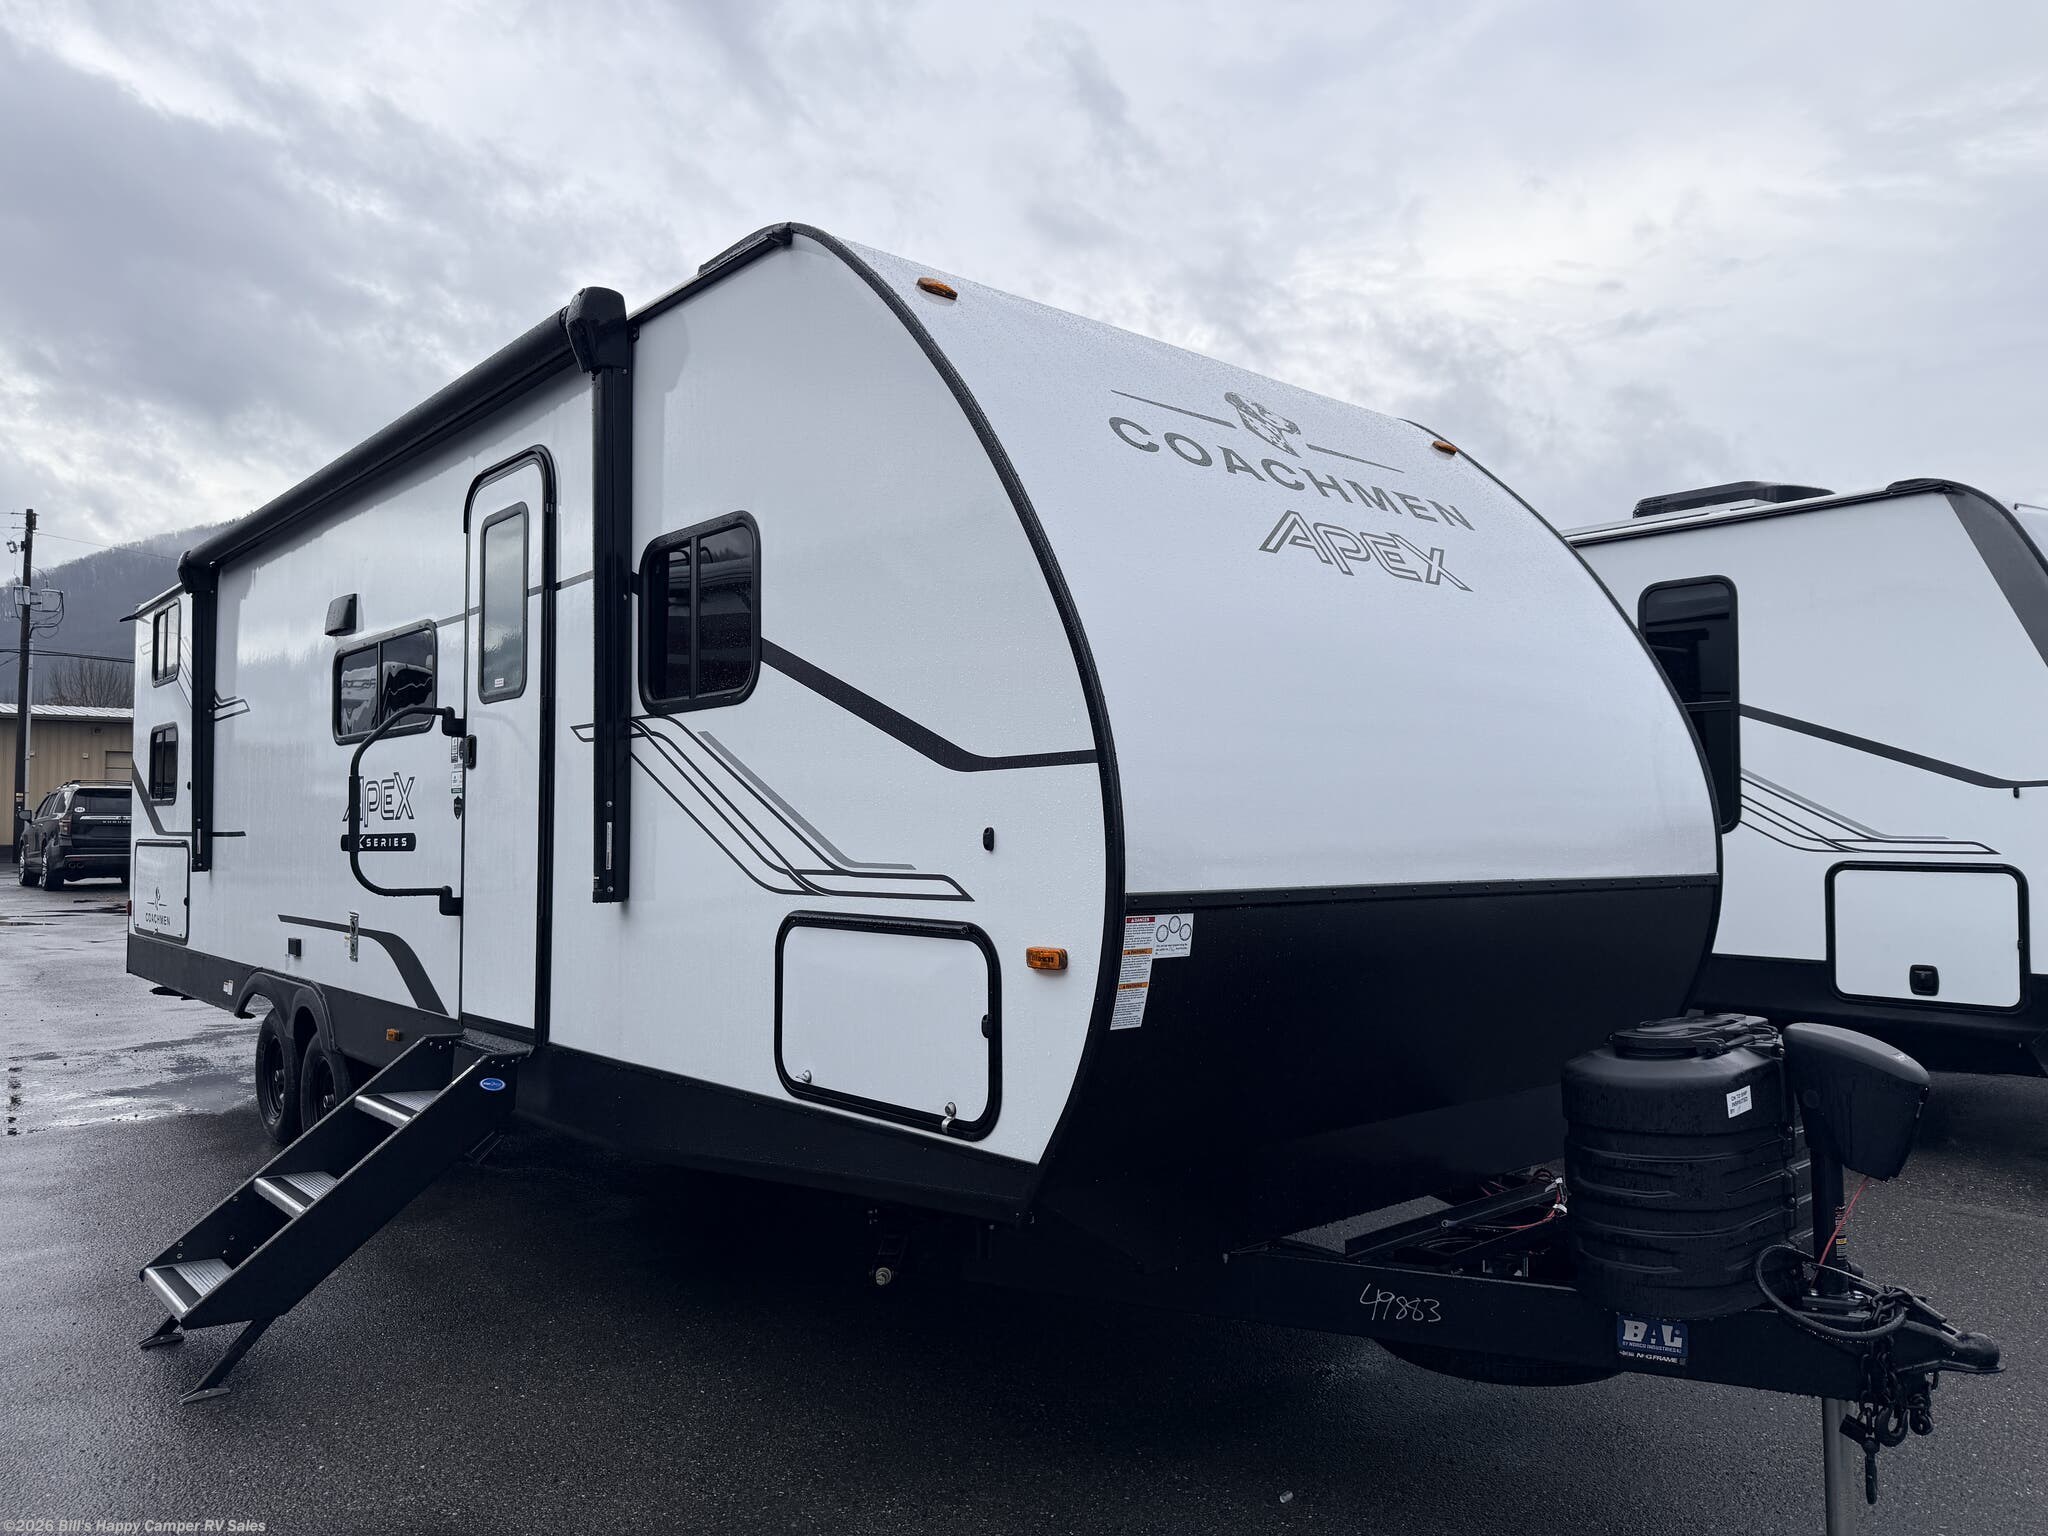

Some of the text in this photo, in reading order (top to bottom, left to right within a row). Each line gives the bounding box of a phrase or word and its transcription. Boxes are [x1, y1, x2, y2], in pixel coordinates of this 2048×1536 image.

[1108, 416, 1475, 531] COACHMEN
[1258, 509, 1474, 592] APEX
[145, 912, 171, 926] COACHMEN
[1359, 1282, 1442, 1322] 49883
[1622, 1319, 1683, 1348] BAL
